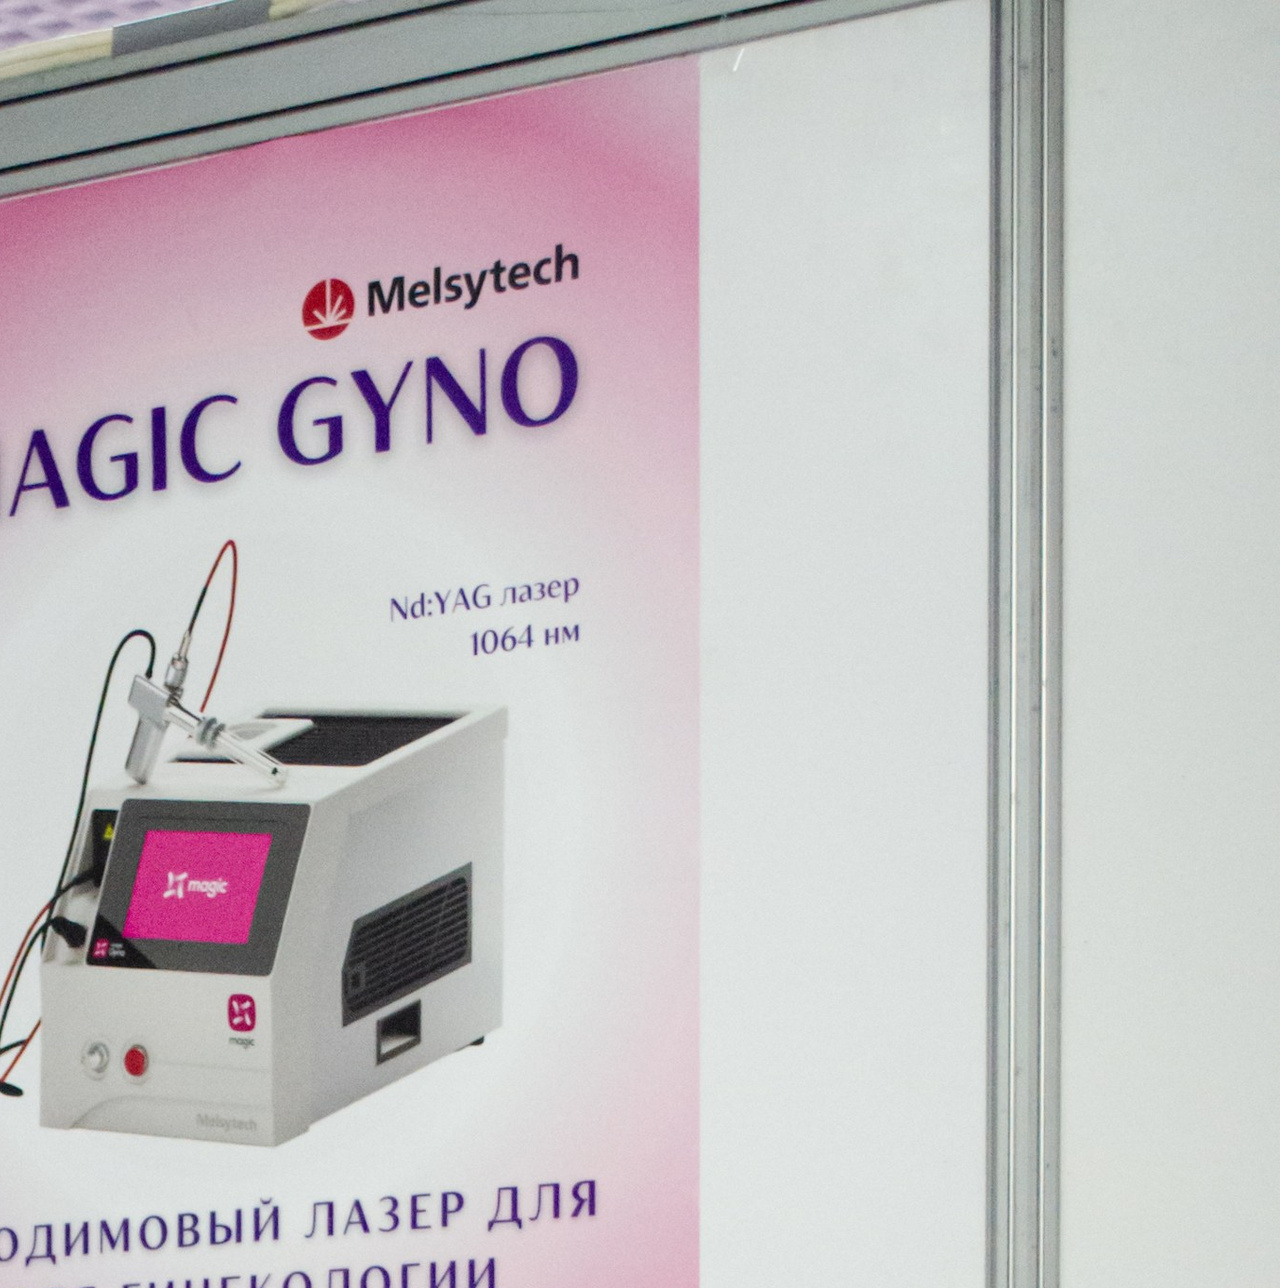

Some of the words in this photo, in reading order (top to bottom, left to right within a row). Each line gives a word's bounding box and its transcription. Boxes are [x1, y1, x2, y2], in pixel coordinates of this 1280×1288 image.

[368, 243, 581, 319] Melsytech
[276, 335, 580, 467] GYNO
[389, 586, 494, 623] Nd:YAG
[500, 573, 581, 613] лазер
[471, 627, 535, 656] 1064
[544, 624, 581, 645] нм
[187, 878, 229, 899] magic
[305, 1191, 465, 1240] ЛАЗЕР
[487, 1178, 599, 1230] ДЛЯ
